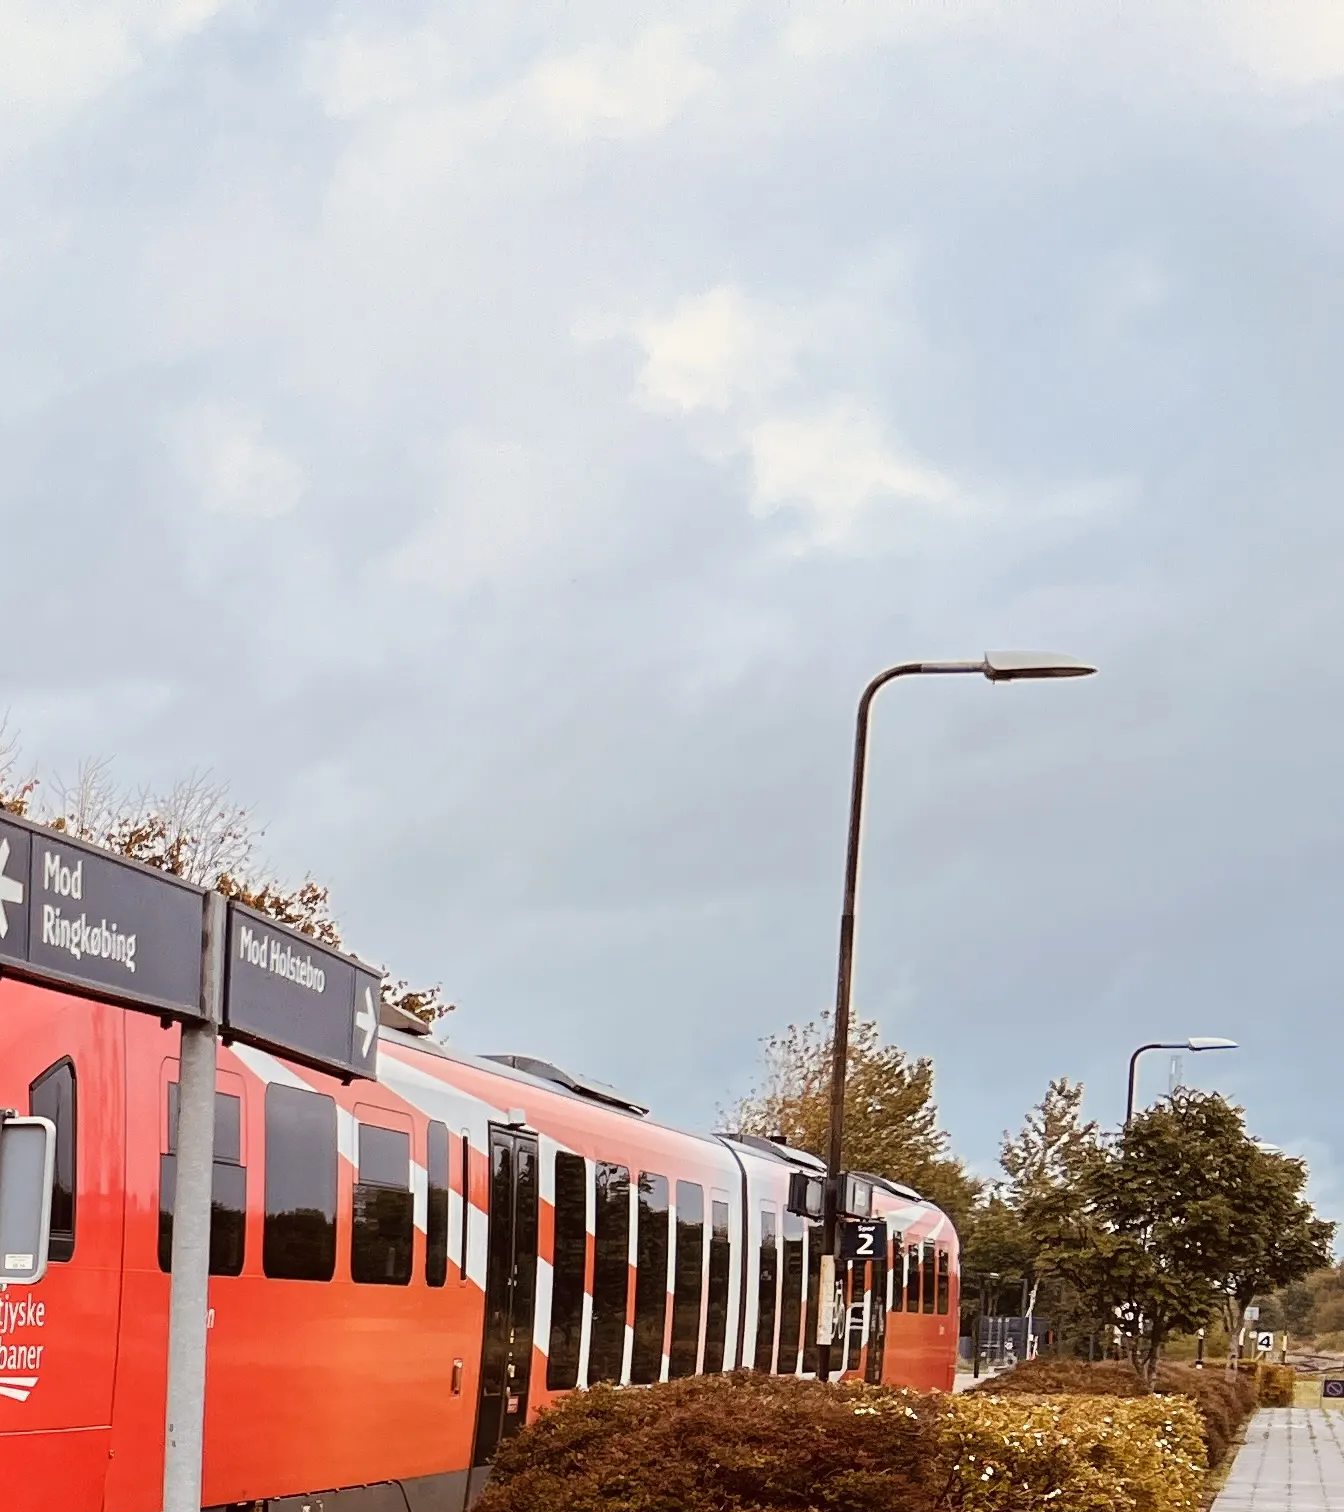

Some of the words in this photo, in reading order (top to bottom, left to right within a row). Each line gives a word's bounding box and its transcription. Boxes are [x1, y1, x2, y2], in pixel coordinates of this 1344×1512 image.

[43, 851, 83, 901] Mod
[42, 907, 138, 974] Ringkøbing
[239, 926, 268, 970] Mod
[269, 941, 327, 994] Holstebro
[856, 1233, 874, 1255] 2
[1258, 1335, 1272, 1348] 4
